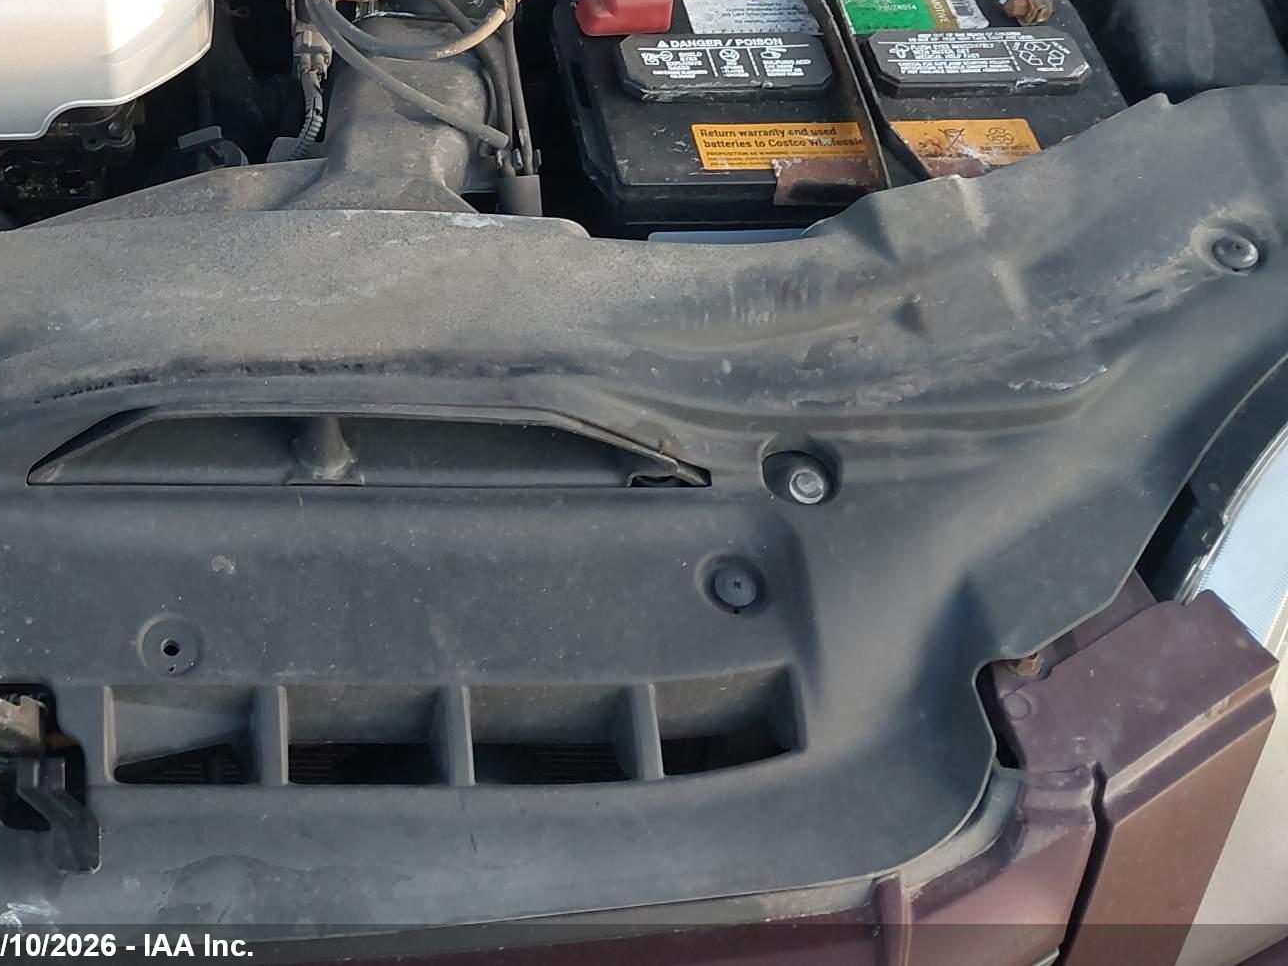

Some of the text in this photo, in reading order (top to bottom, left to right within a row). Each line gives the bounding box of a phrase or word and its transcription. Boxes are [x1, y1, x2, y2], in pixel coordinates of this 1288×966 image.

[670, 38, 723, 48] DANGER
[734, 37, 784, 46] POISON
[700, 128, 736, 138] Return
[738, 128, 785, 141] warranty
[811, 127, 837, 137] used
[703, 139, 752, 149] batteries
[754, 140, 766, 148] to
[768, 139, 806, 148] Costco
